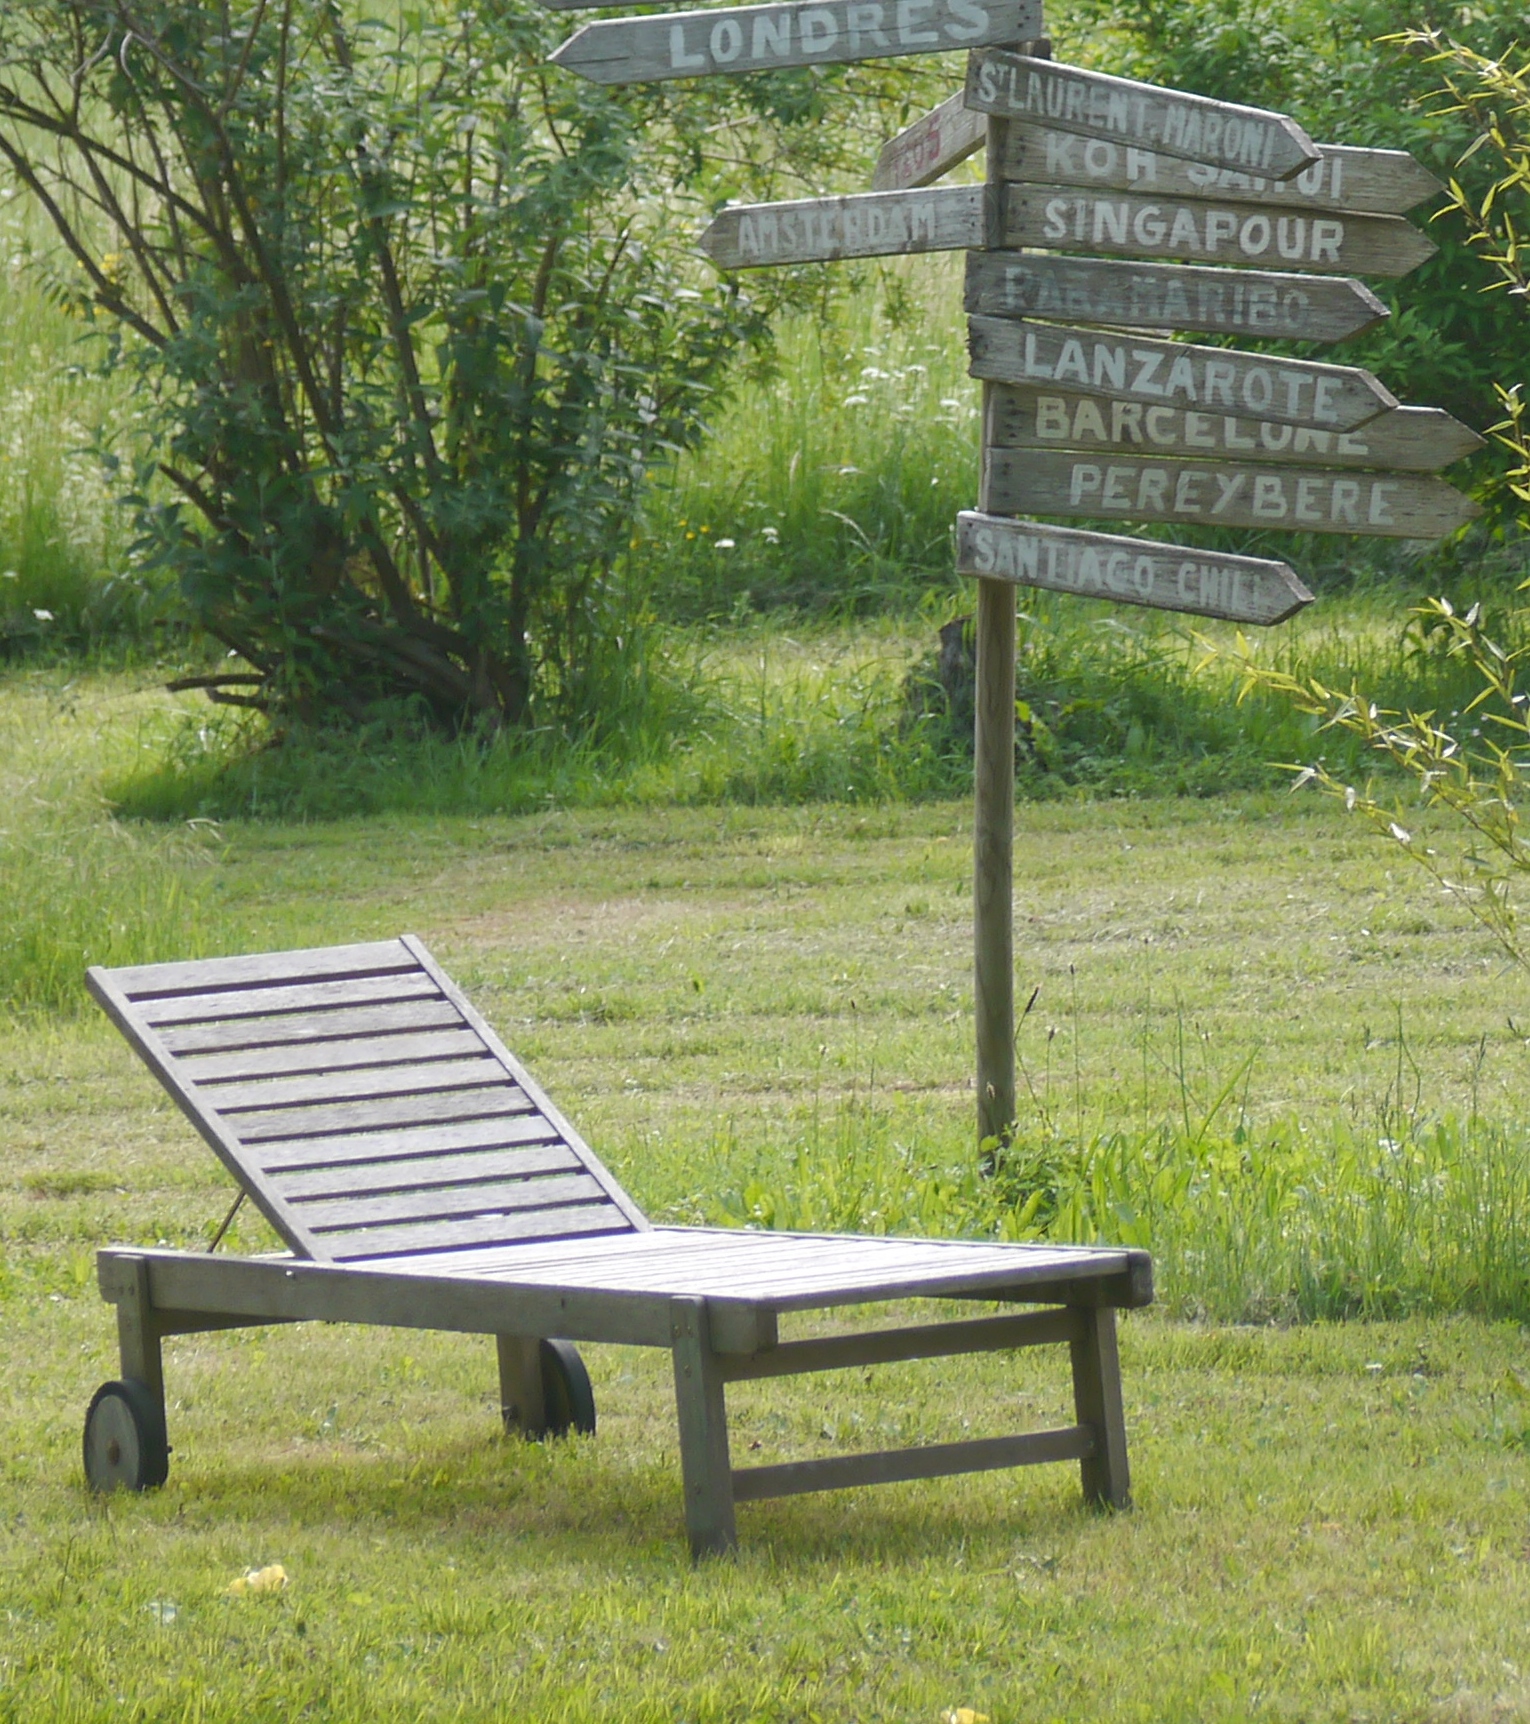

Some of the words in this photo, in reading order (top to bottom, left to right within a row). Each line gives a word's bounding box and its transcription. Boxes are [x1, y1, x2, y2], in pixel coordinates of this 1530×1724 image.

[1046, 132, 1157, 182] KOH
[738, 202, 936, 255] AMSTERDAM
[1043, 199, 1344, 263] SINGAPOUR
[1025, 333, 1343, 422] LANZAROTE
[1070, 464, 1399, 525] PEREYBERE
[974, 528, 1154, 596] SANTIAGO
